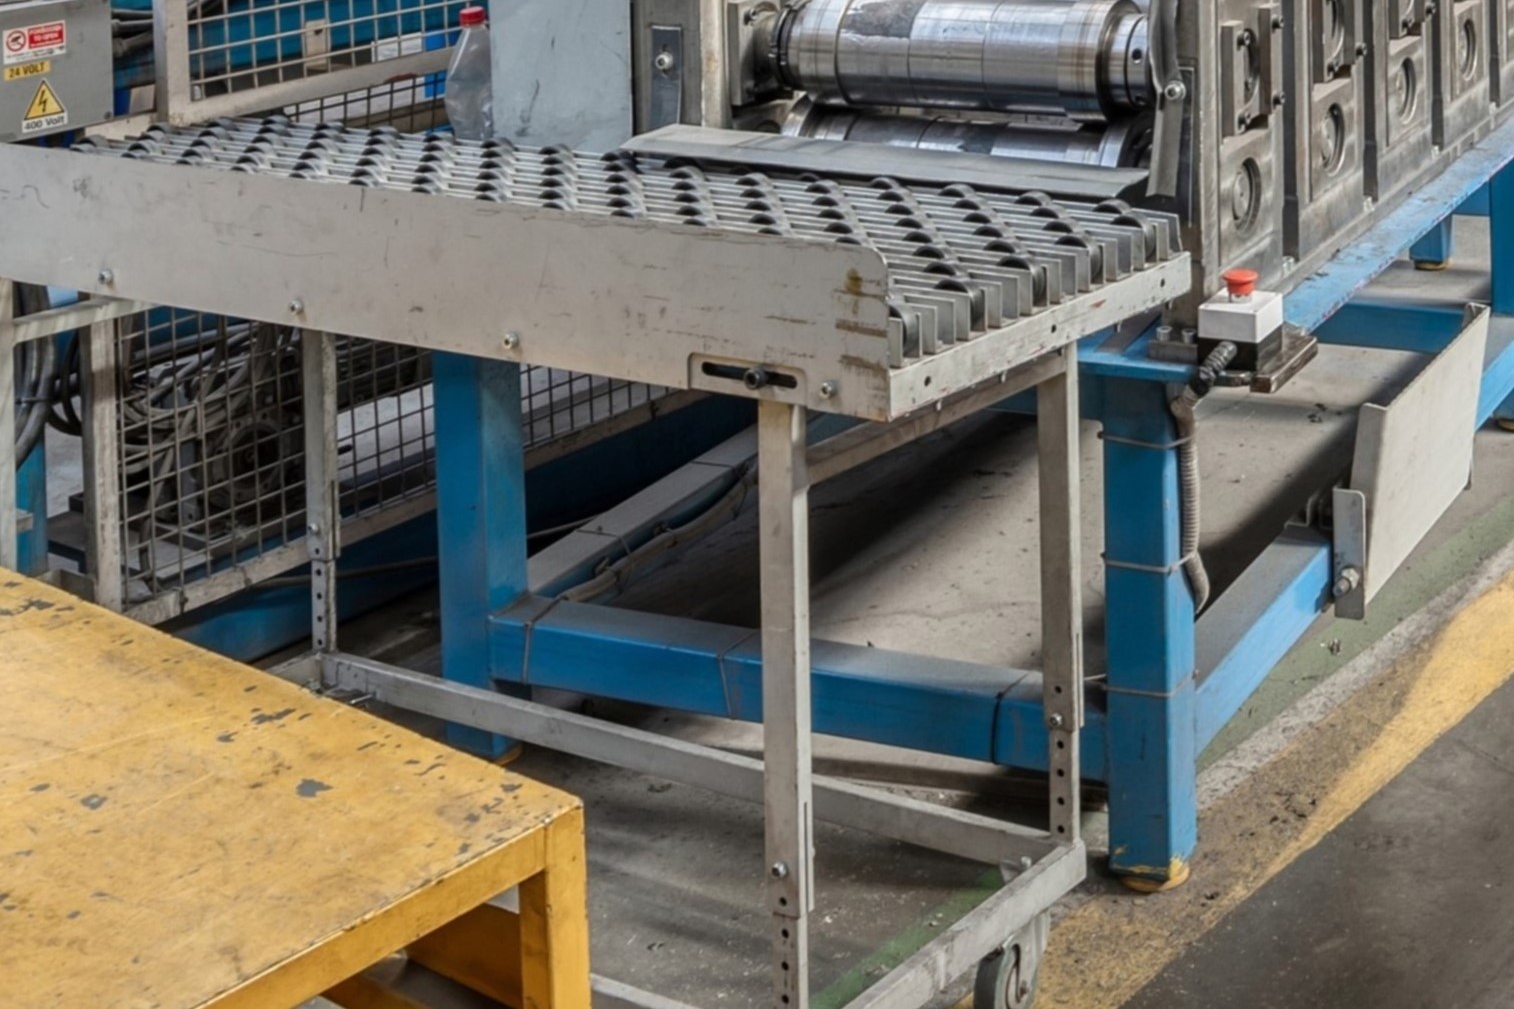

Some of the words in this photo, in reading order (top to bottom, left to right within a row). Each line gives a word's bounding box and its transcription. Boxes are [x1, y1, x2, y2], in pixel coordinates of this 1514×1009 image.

[9, 67, 20, 78] 24
[22, 61, 45, 75] VOLT
[25, 120, 43, 130] 400
